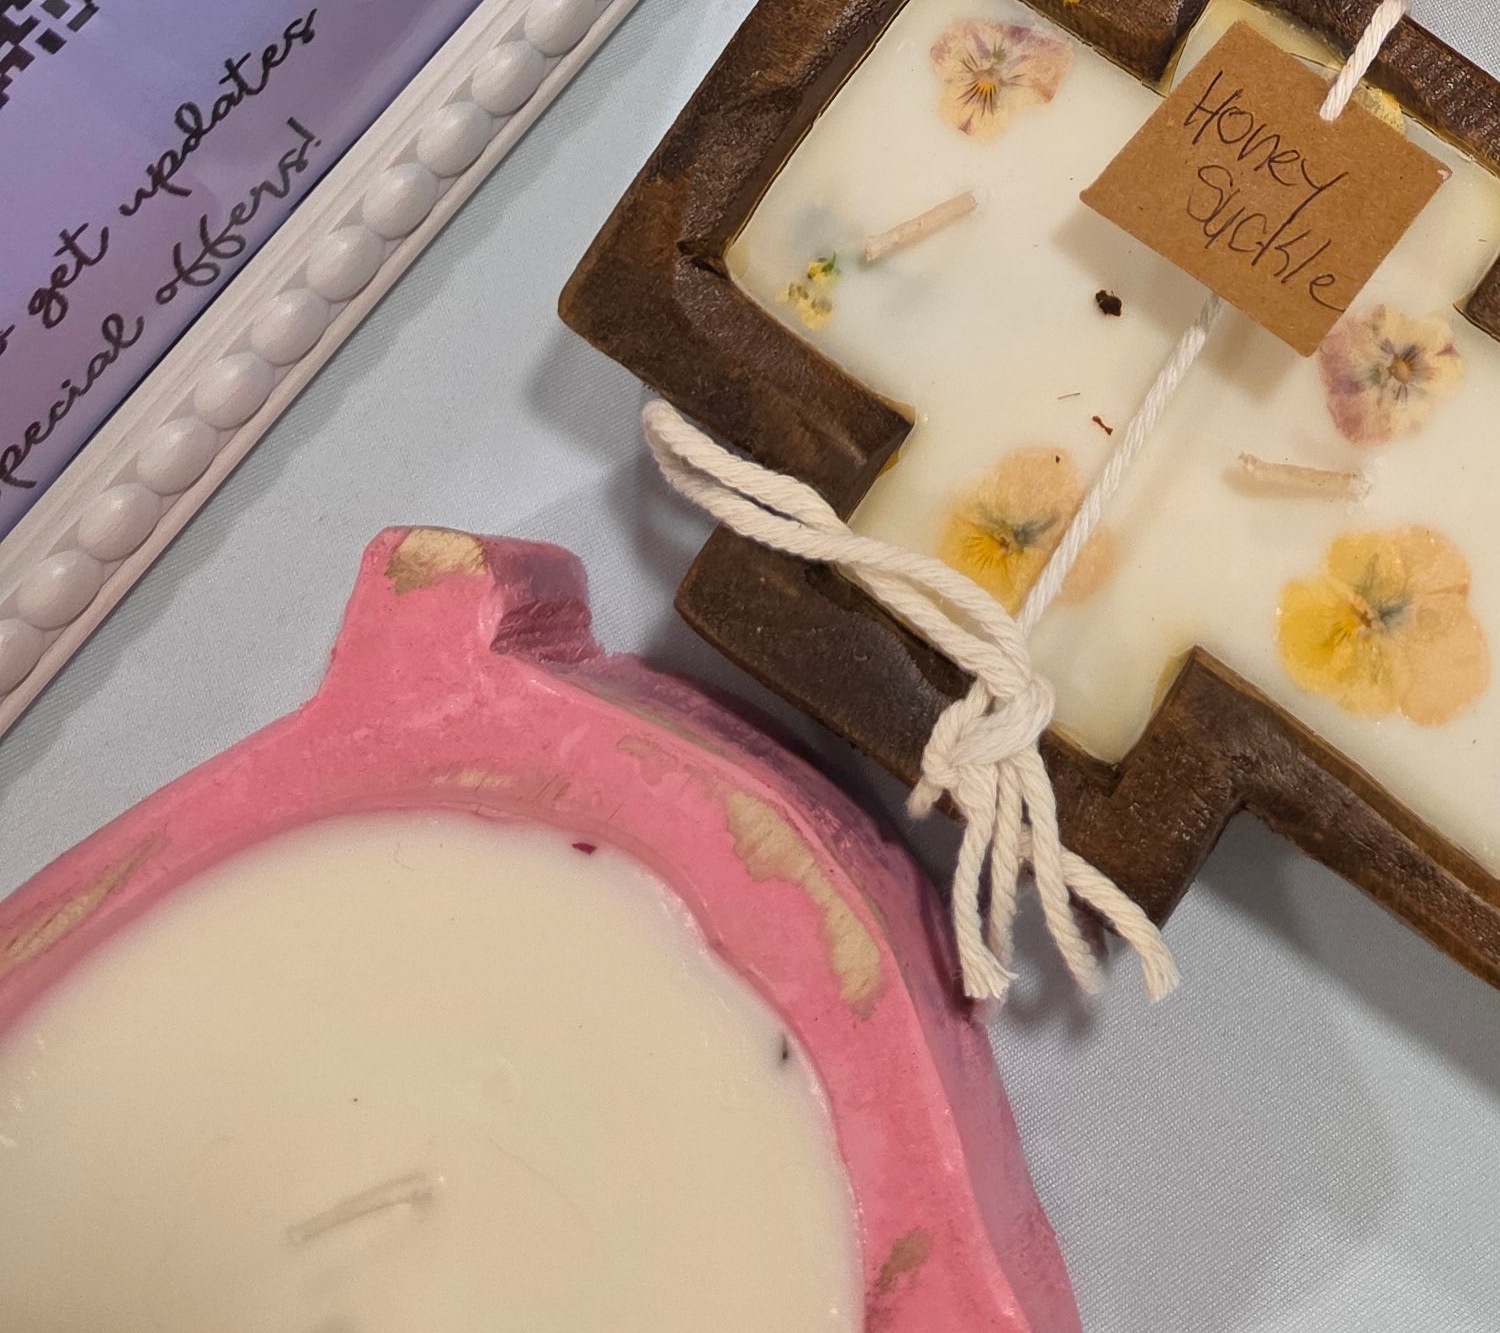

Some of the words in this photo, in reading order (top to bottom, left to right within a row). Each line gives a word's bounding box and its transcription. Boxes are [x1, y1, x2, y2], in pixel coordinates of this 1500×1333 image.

[0, 312, 145, 490] pecial
[156, 117, 322, 306] offers!
[28, 222, 109, 329] get
[119, 8, 318, 217] updates
